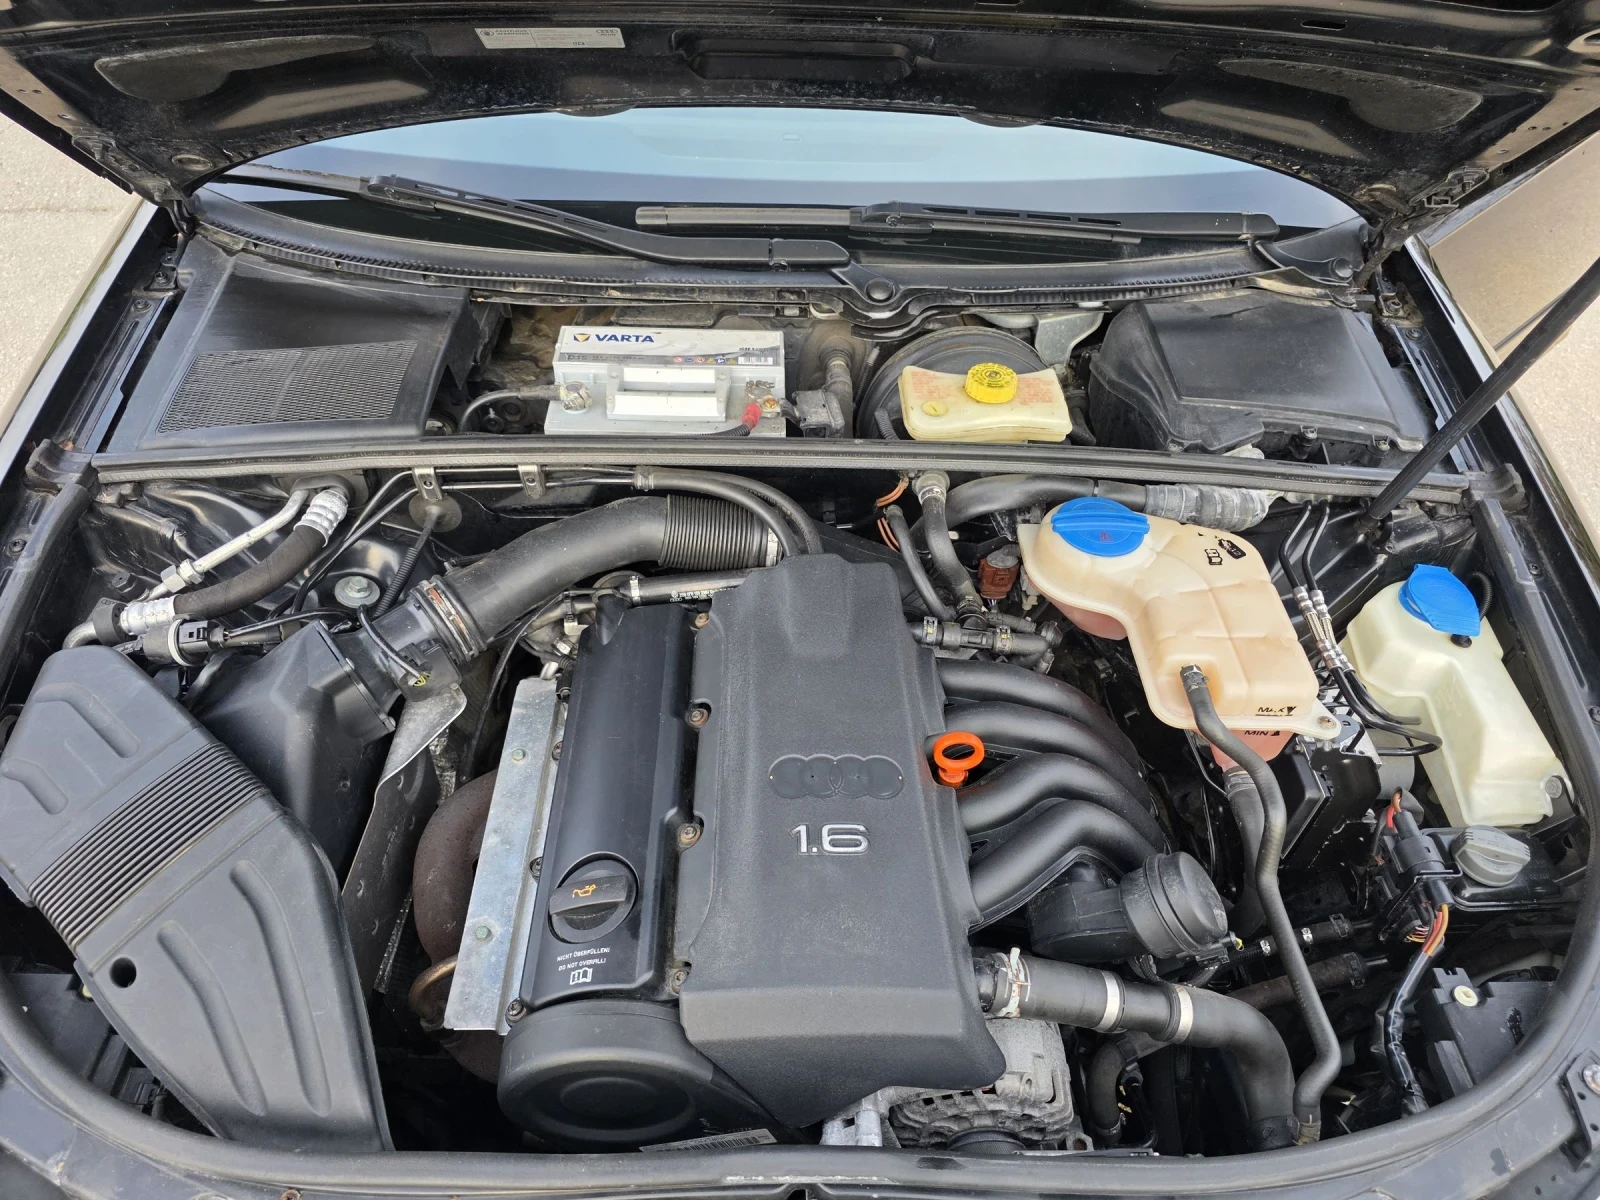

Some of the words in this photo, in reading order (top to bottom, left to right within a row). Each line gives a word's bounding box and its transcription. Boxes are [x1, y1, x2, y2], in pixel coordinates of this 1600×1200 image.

[595, 334, 655, 343] VARTA
[789, 823, 870, 854] 1.6
[556, 952, 573, 961] NICHT
[567, 961, 578, 969] NOT
[578, 958, 607, 966] OVERFILL!
